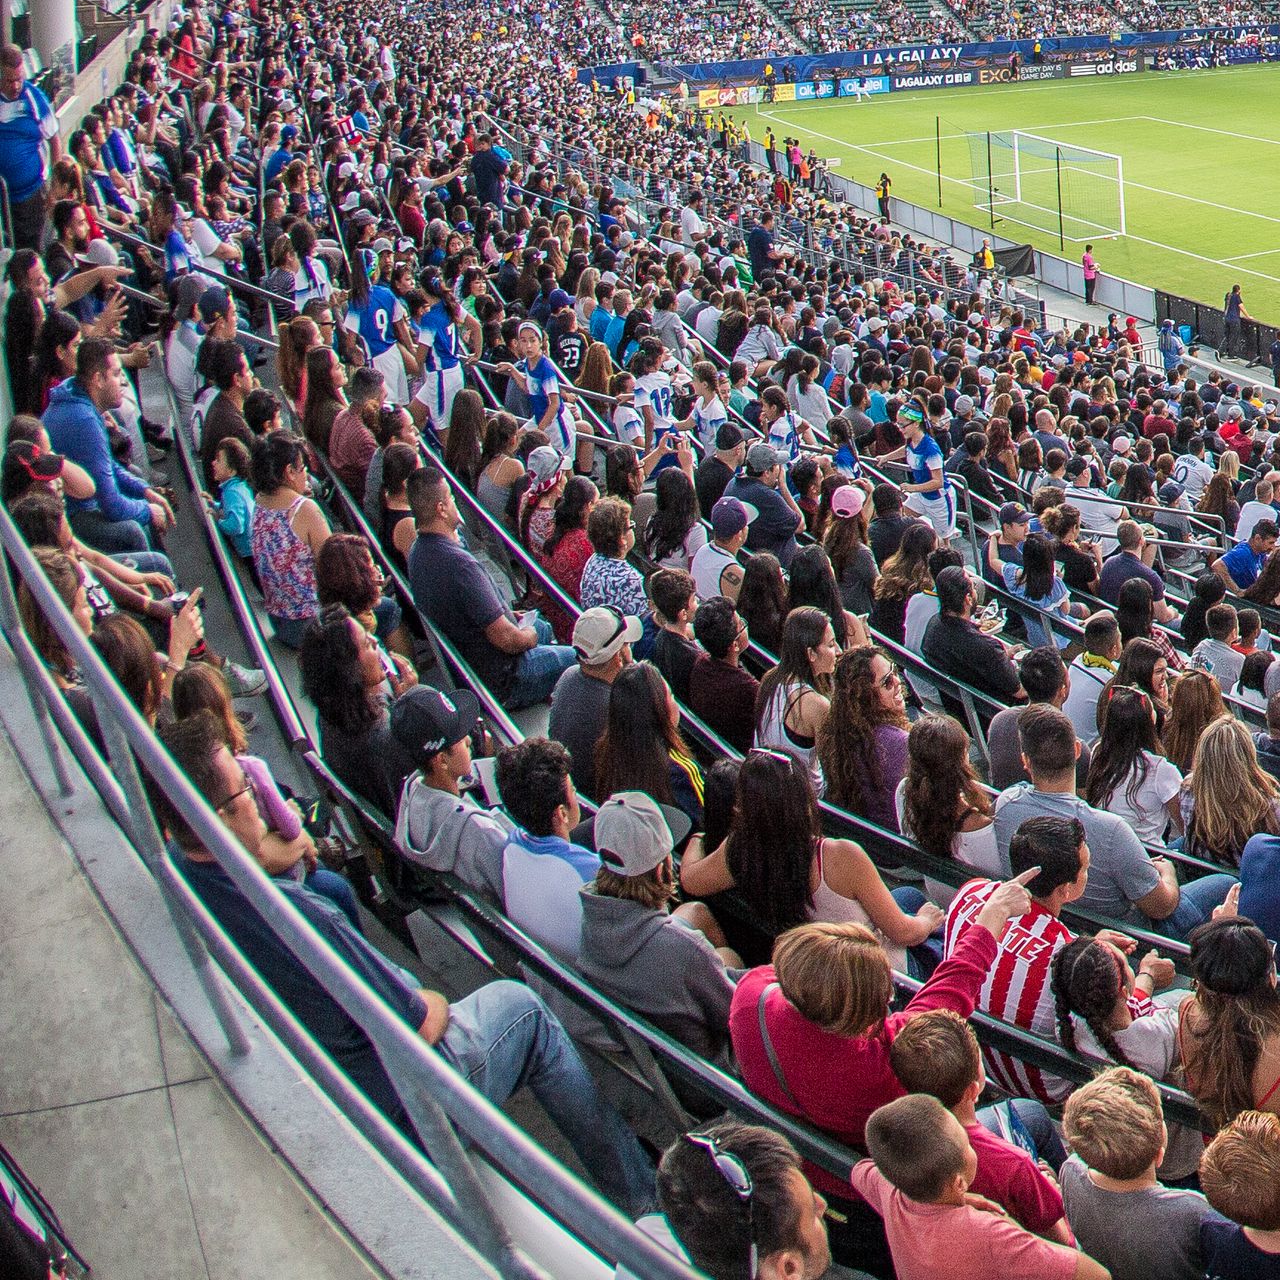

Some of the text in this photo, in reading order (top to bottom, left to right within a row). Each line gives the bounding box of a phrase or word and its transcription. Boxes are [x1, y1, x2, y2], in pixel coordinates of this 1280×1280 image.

[1041, 65, 1055, 73] DAY
[1020, 72, 1039, 80] GAME
[895, 75, 943, 88] LAGALAXY
[375, 308, 388, 341] 9
